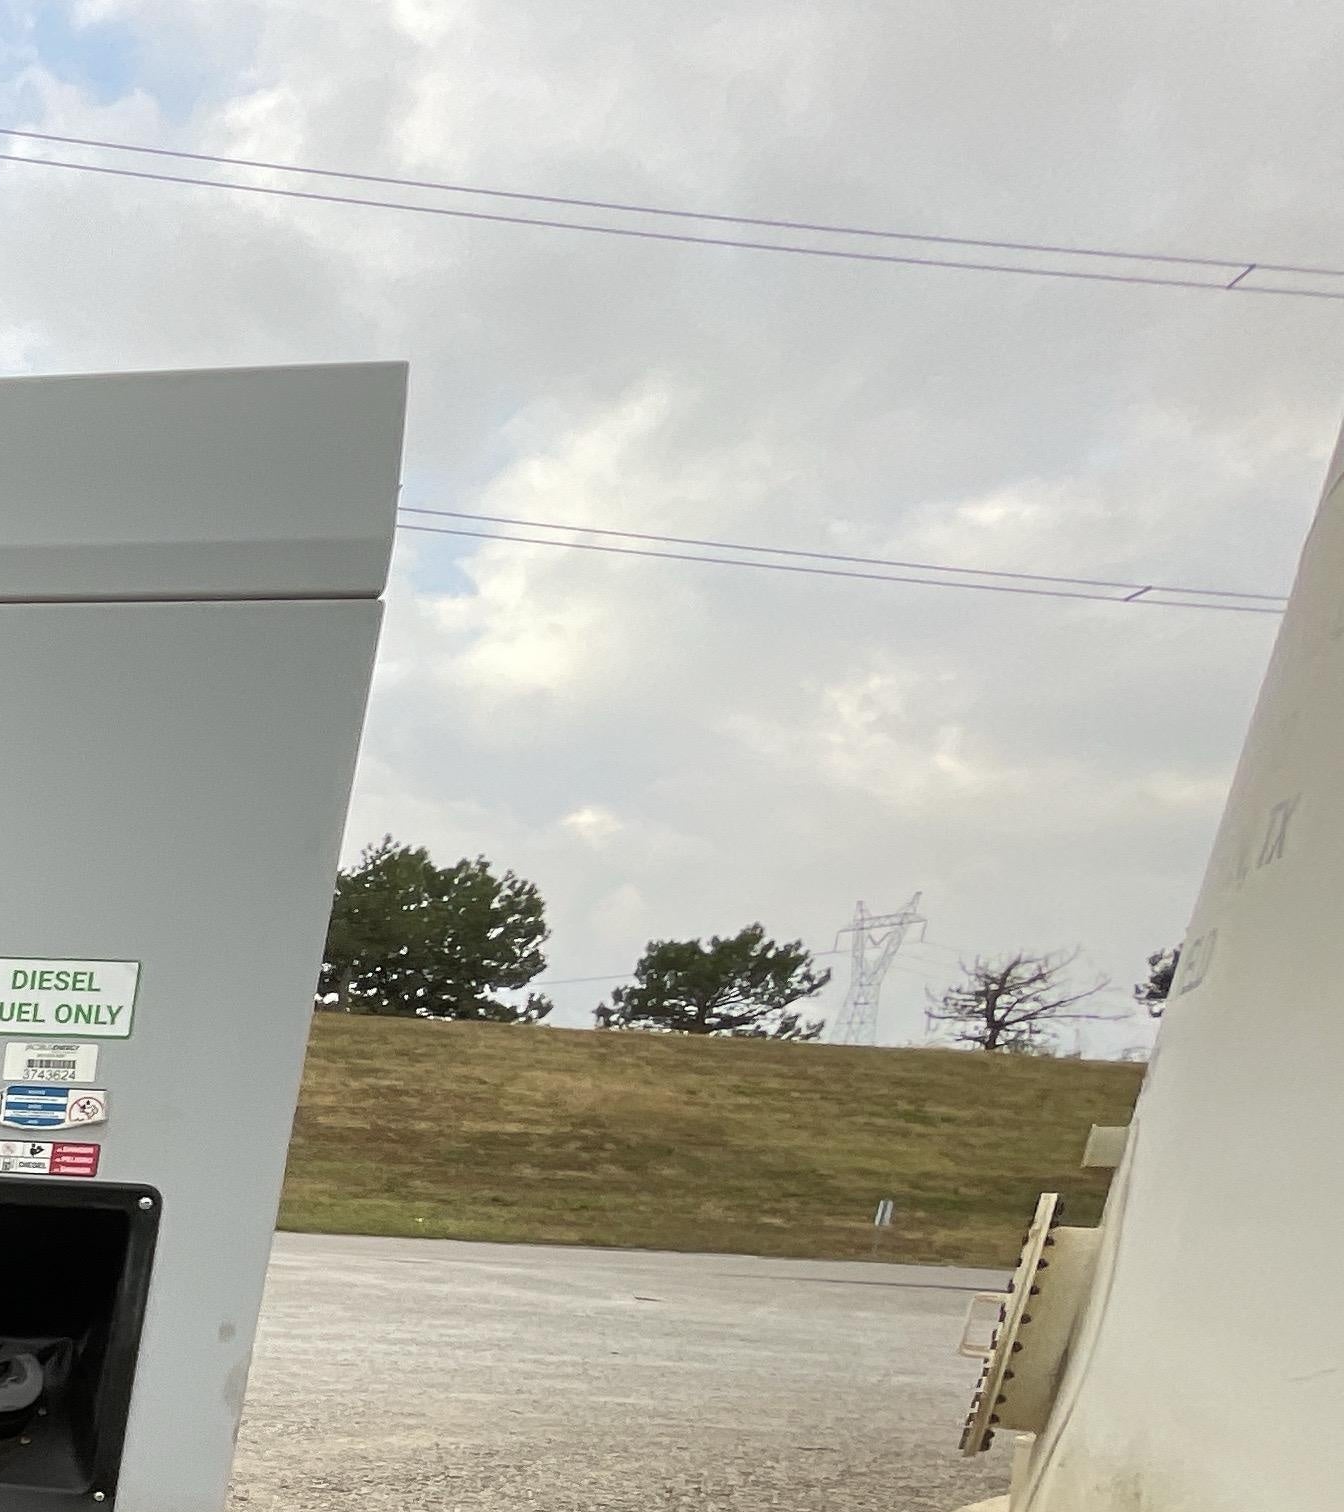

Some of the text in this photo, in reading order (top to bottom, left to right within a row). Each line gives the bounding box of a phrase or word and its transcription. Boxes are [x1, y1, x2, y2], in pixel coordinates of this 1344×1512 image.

[11, 969, 101, 992] DIESEL
[54, 1003, 124, 1025] ONLY
[22, 1069, 76, 1081] 3743624
